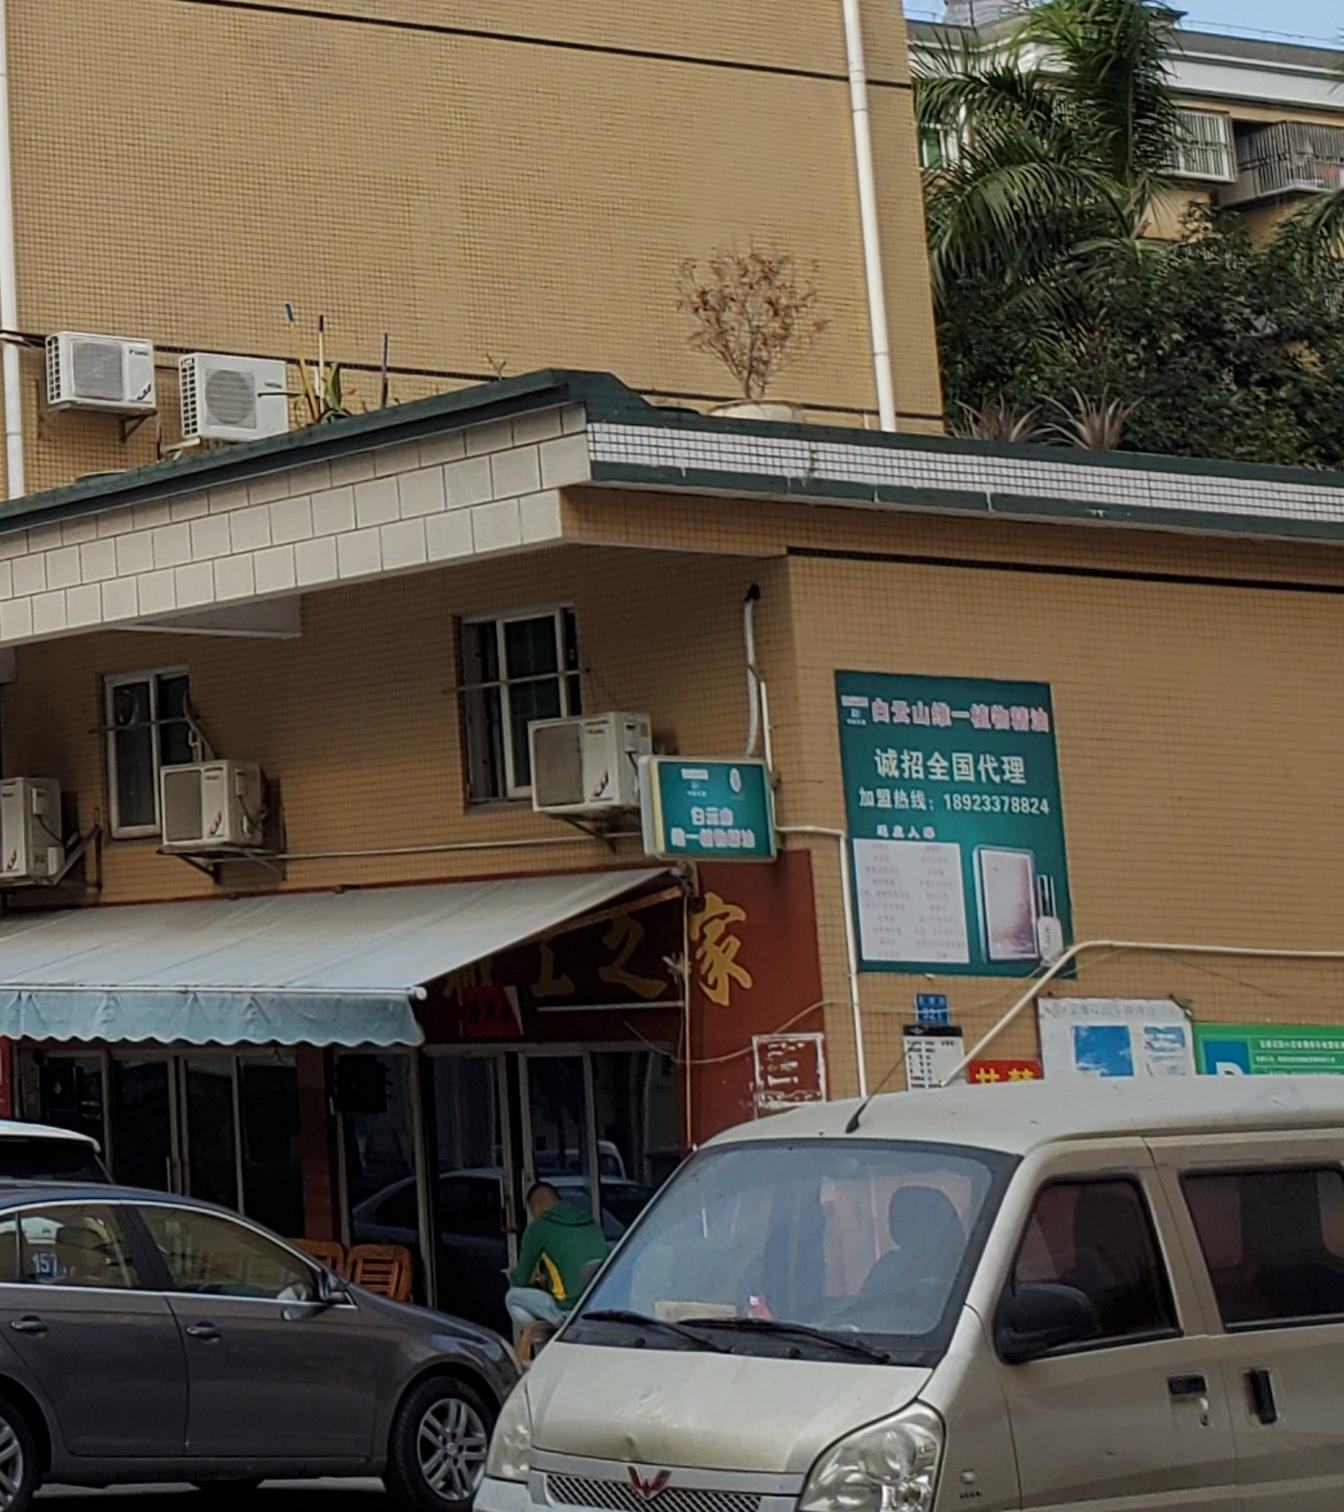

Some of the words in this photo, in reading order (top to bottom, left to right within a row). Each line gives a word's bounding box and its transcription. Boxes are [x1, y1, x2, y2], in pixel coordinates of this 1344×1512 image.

[874, 748, 1026, 784] 诚招全国代理
